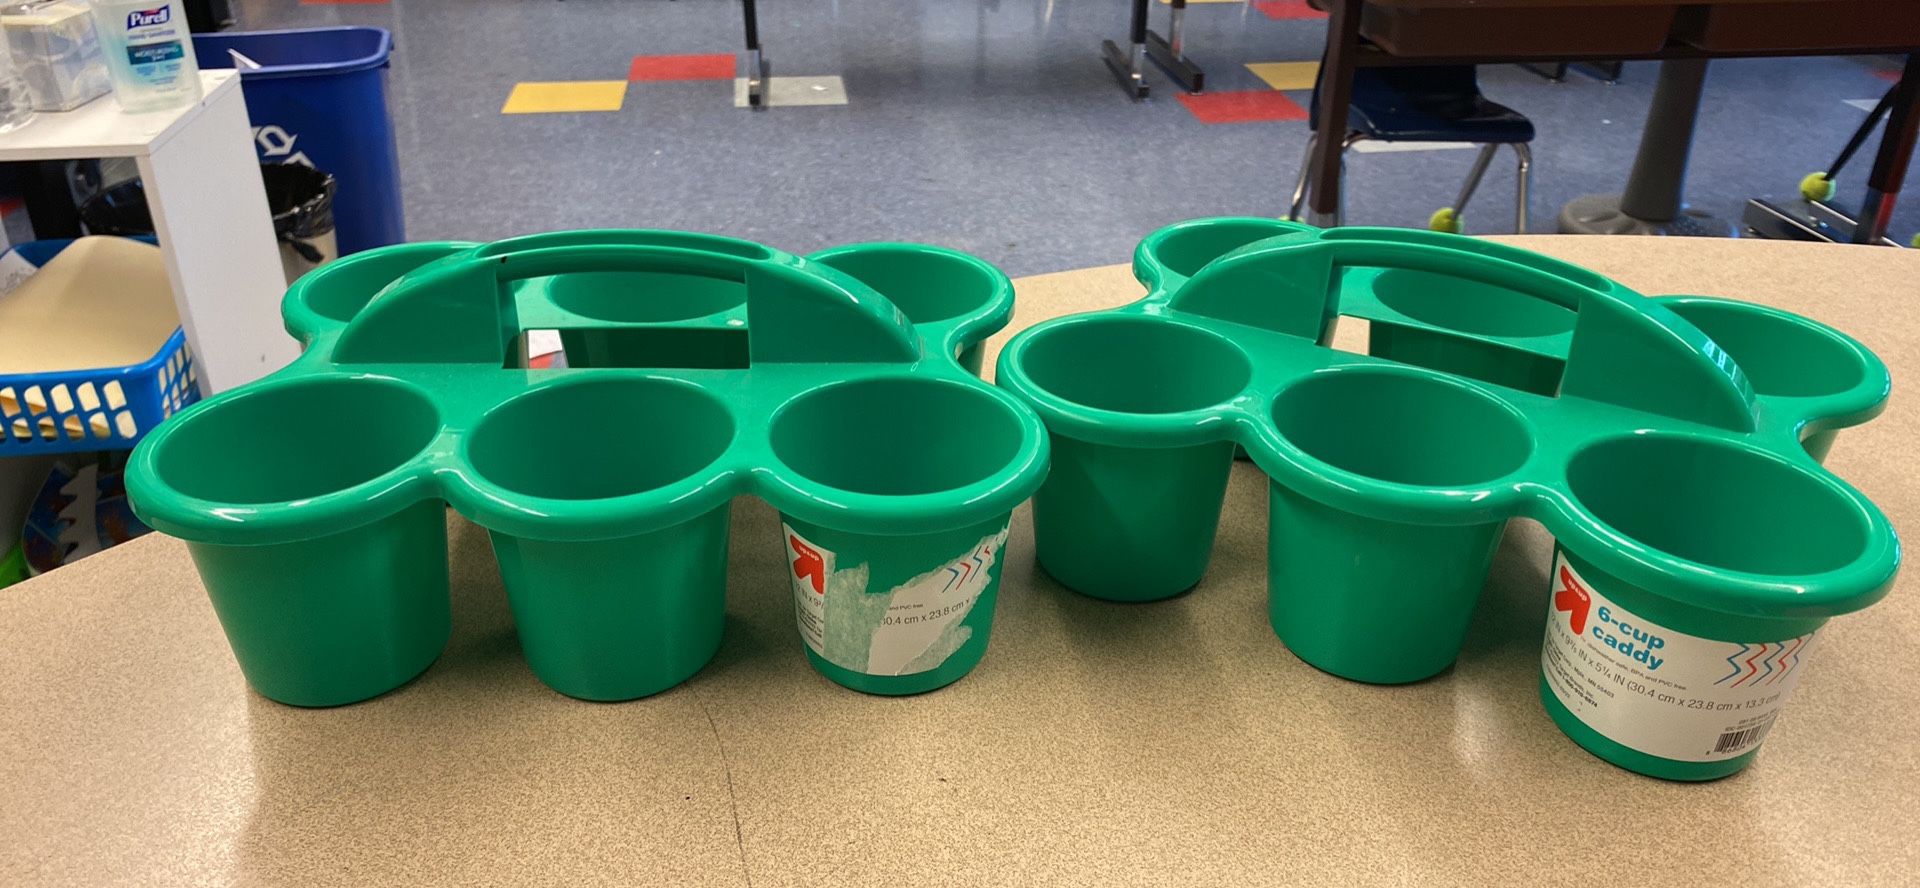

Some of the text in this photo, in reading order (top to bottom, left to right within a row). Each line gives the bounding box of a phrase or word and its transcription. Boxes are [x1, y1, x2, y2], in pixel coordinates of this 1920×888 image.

[130, 9, 168, 26] Purell
[904, 616, 918, 624] cm
[929, 607, 950, 620] 23.8
[951, 602, 964, 612] cm
[1598, 606, 1665, 650] 6-cup
[1592, 626, 1664, 670] caddy
[1578, 649, 1588, 661] IN
[1613, 673, 1625, 686] IN
[1627, 680, 1655, 698] (30.4
[1658, 693, 1675, 704] cm
[1687, 699, 1714, 710] 23.8
[1716, 703, 1733, 711] cm
